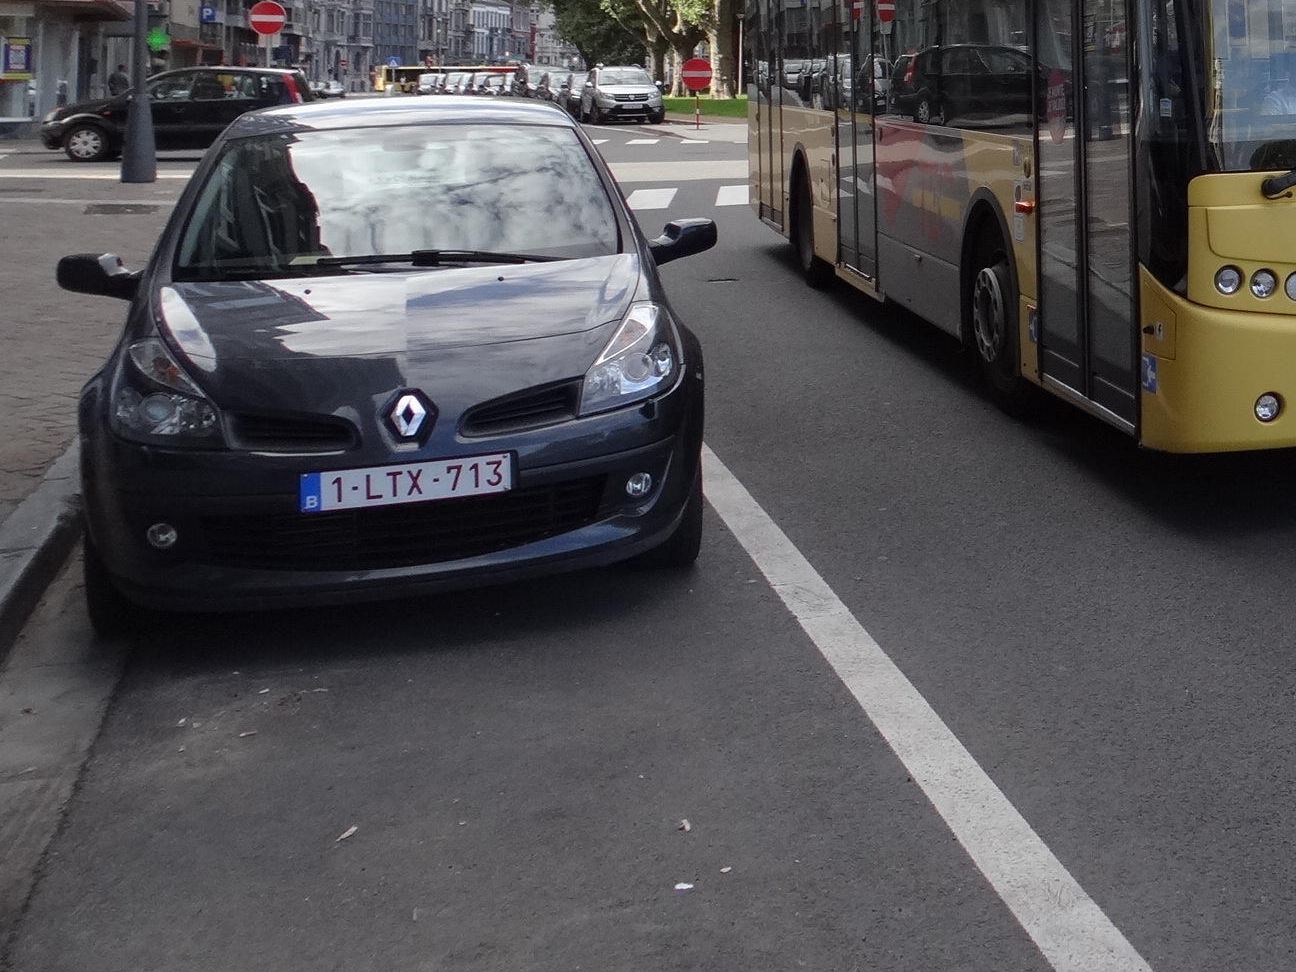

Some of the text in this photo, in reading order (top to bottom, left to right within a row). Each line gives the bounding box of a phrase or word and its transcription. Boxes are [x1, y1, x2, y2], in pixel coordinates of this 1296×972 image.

[202, 7, 213, 20] P
[305, 459, 504, 509] B 1-LTX-713
